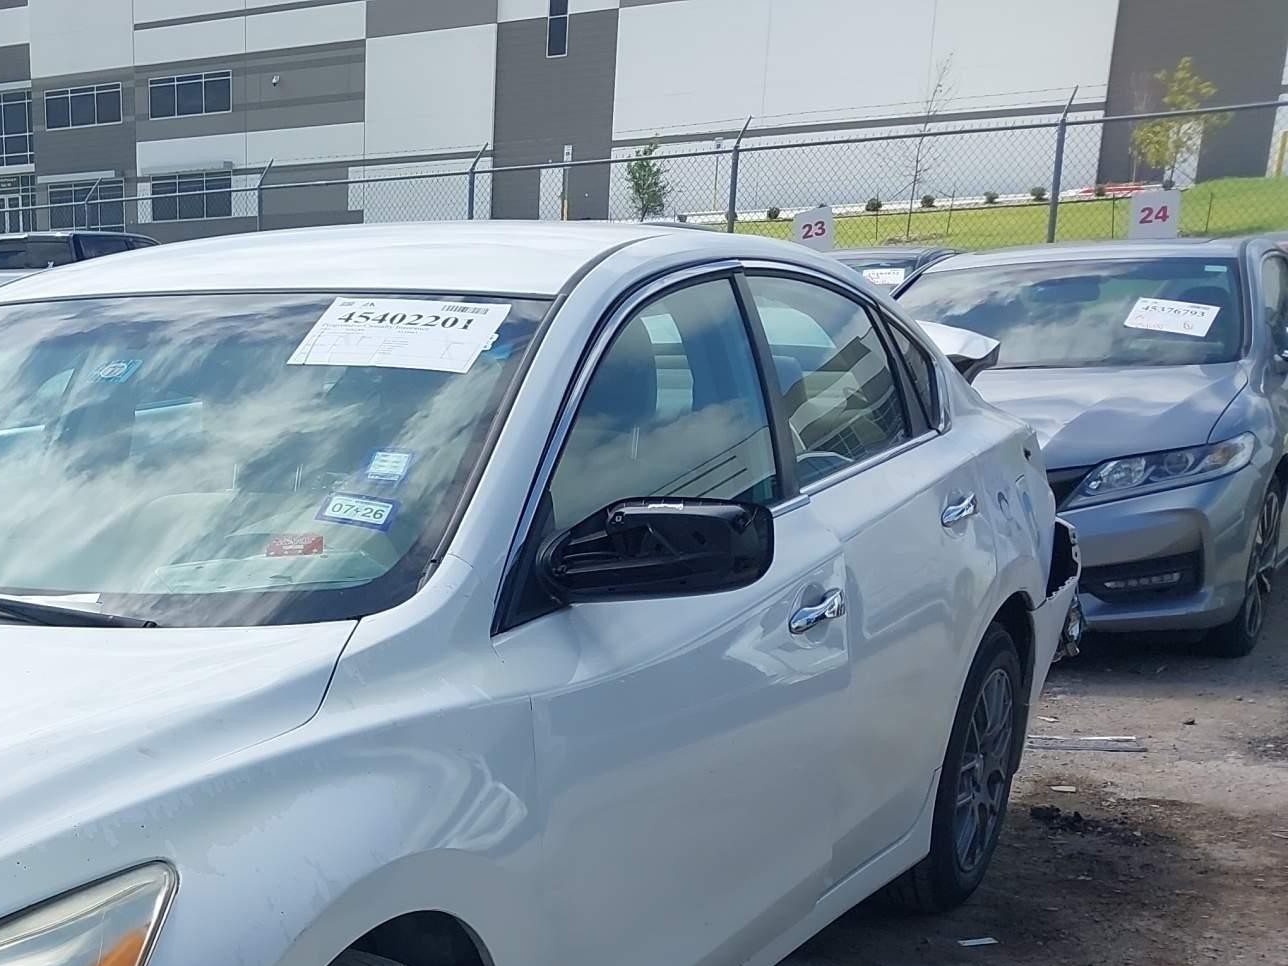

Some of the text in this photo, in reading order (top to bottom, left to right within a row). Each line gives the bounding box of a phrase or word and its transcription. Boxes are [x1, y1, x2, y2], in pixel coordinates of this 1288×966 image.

[1139, 206, 1169, 224] 24
[802, 221, 826, 239] 23
[338, 311, 475, 331] 45402201
